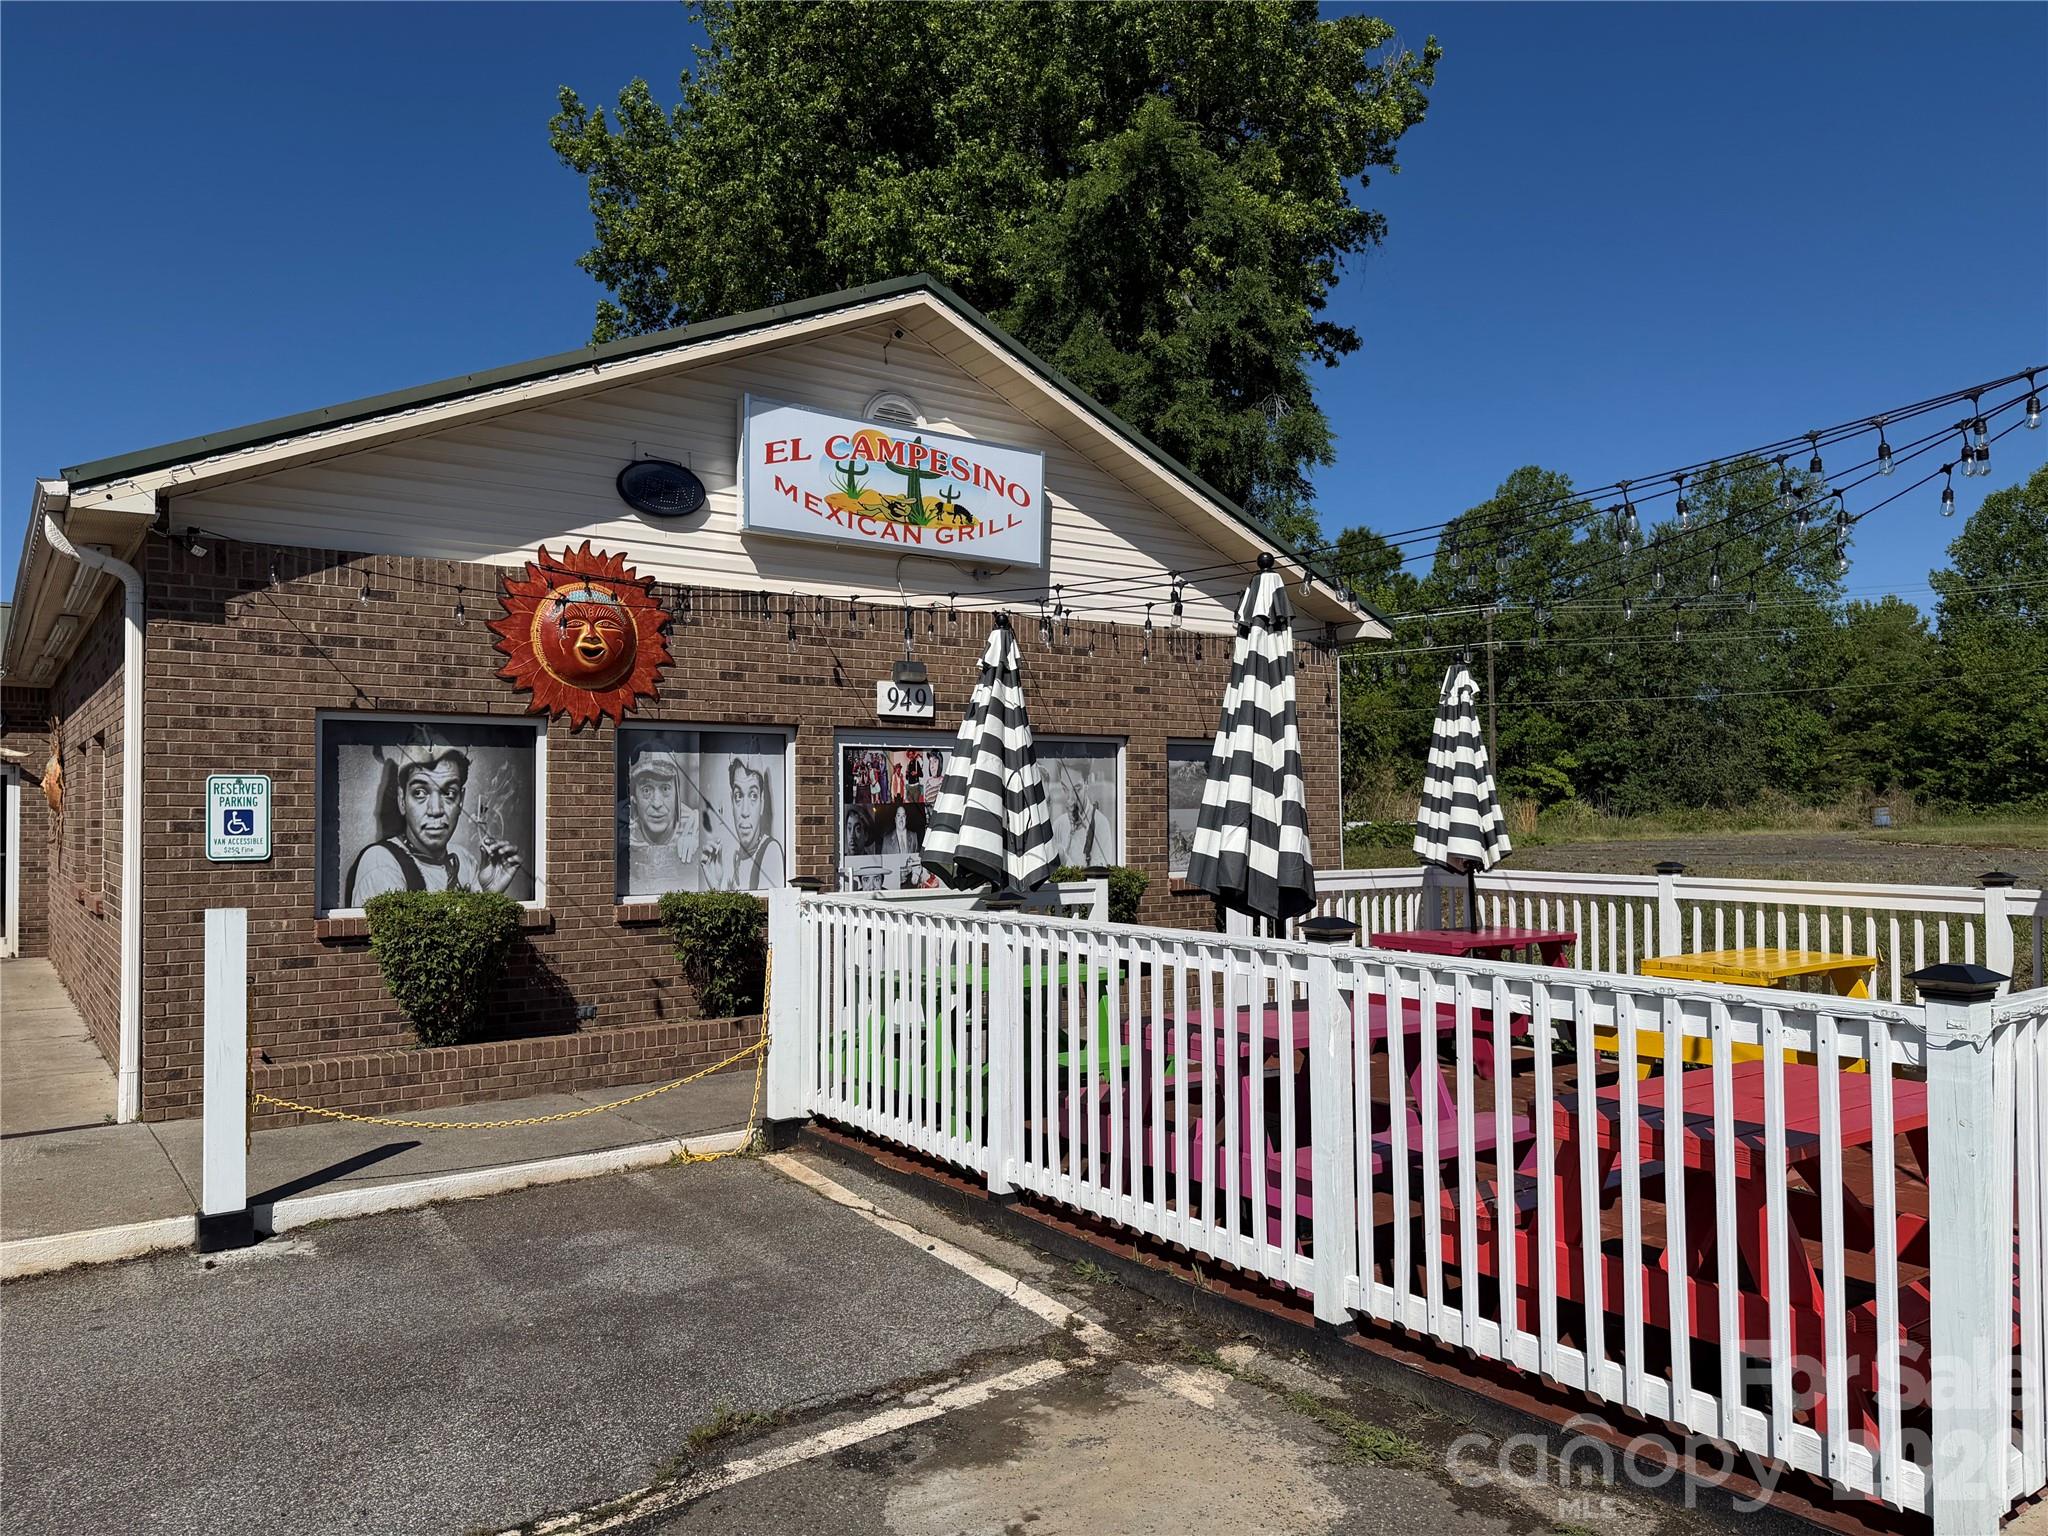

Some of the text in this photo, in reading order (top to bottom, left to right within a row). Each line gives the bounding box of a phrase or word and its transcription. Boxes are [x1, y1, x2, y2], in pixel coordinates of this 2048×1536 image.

[764, 435, 1031, 508] EL CAMPESINO
[774, 474, 1022, 544] MEXICAN GRILL
[887, 686, 927, 713] 949
[213, 783, 264, 795] RESERVED
[219, 796, 258, 807] PARKING
[228, 837, 264, 845] ACCESSIBLE
